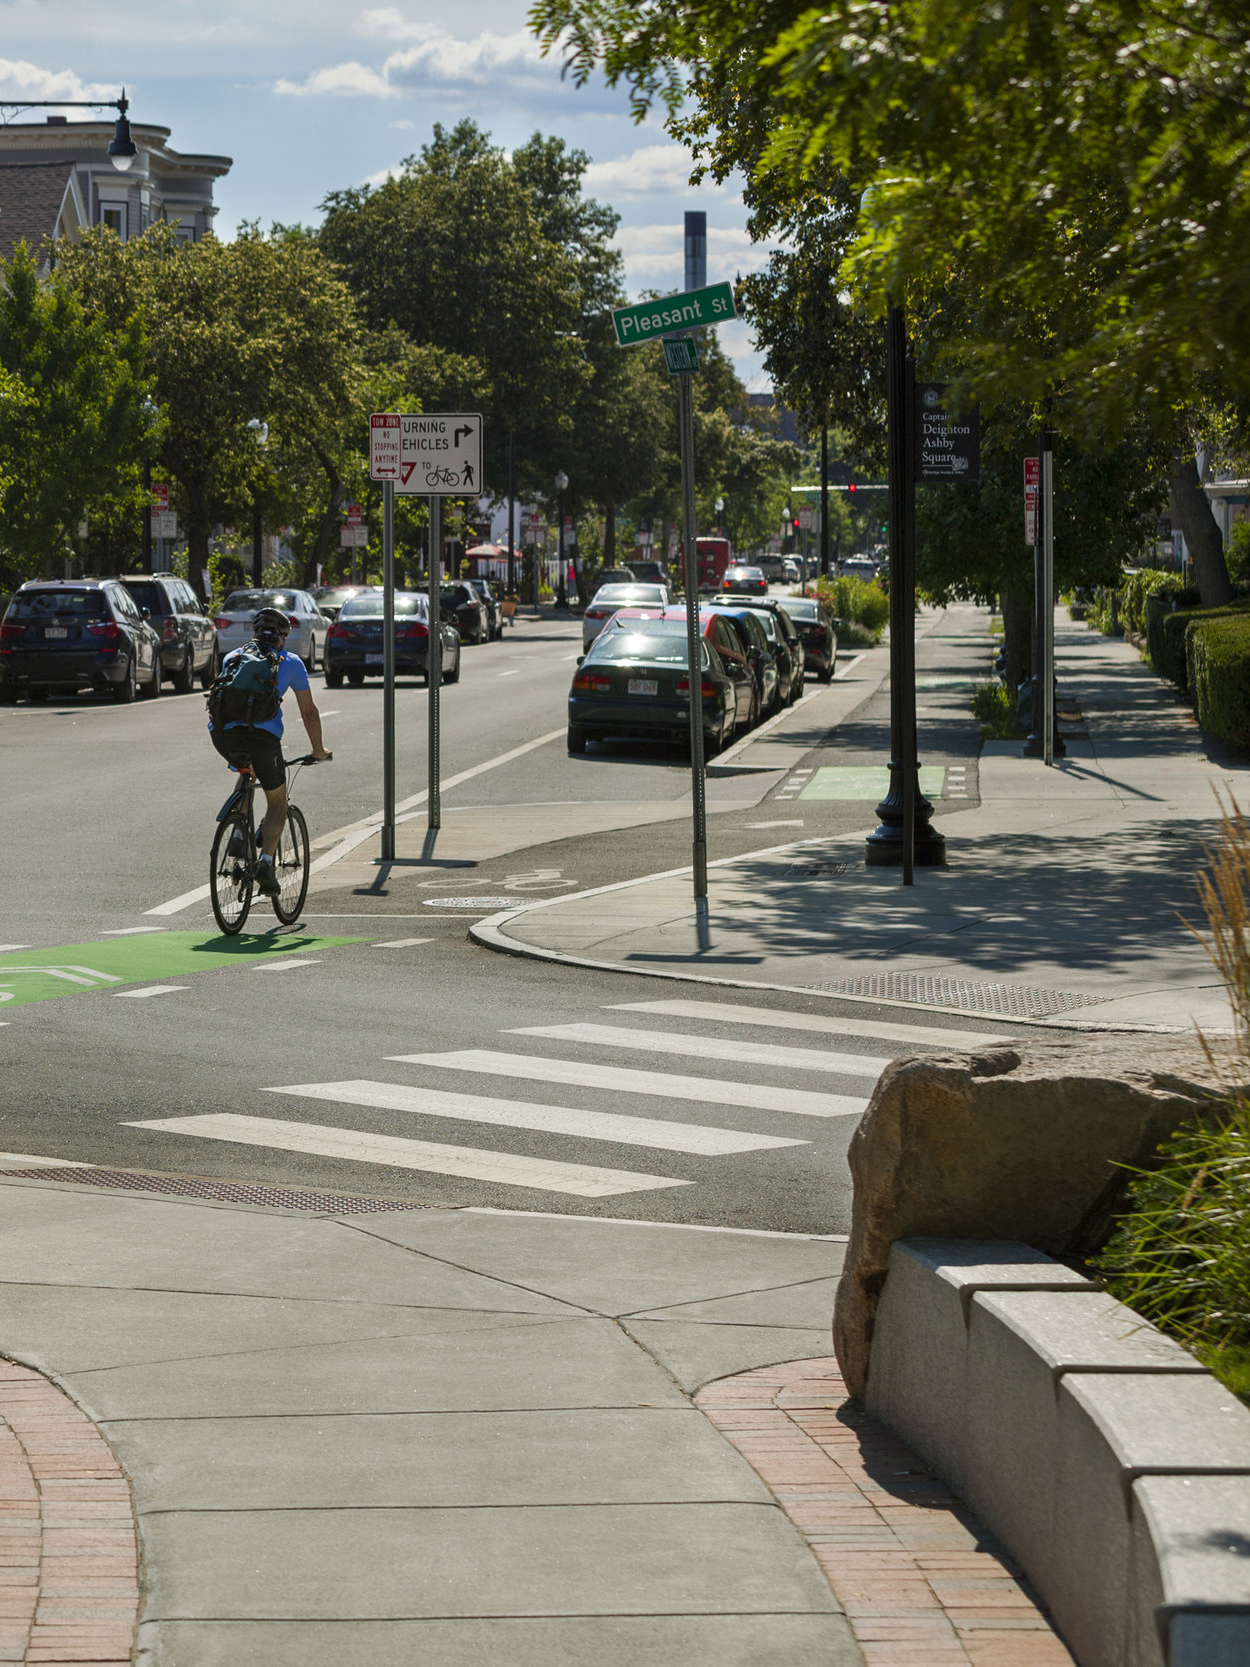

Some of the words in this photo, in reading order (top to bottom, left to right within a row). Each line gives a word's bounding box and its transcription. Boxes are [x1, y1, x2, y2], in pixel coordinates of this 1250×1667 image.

[621, 300, 702, 336] Pleasant
[712, 298, 728, 313] St
[373, 417, 384, 427] TOW
[386, 417, 399, 427] ZONE
[402, 421, 446, 433] URNING
[383, 431, 391, 439] NO
[923, 424, 970, 437] Deighton
[374, 442, 398, 451] STOPPING
[403, 439, 449, 450] EHICLES
[923, 437, 955, 451] Ashby
[374, 454, 398, 464] ANYTIME
[922, 451, 956, 464] Square
[422, 462, 432, 470] TO
